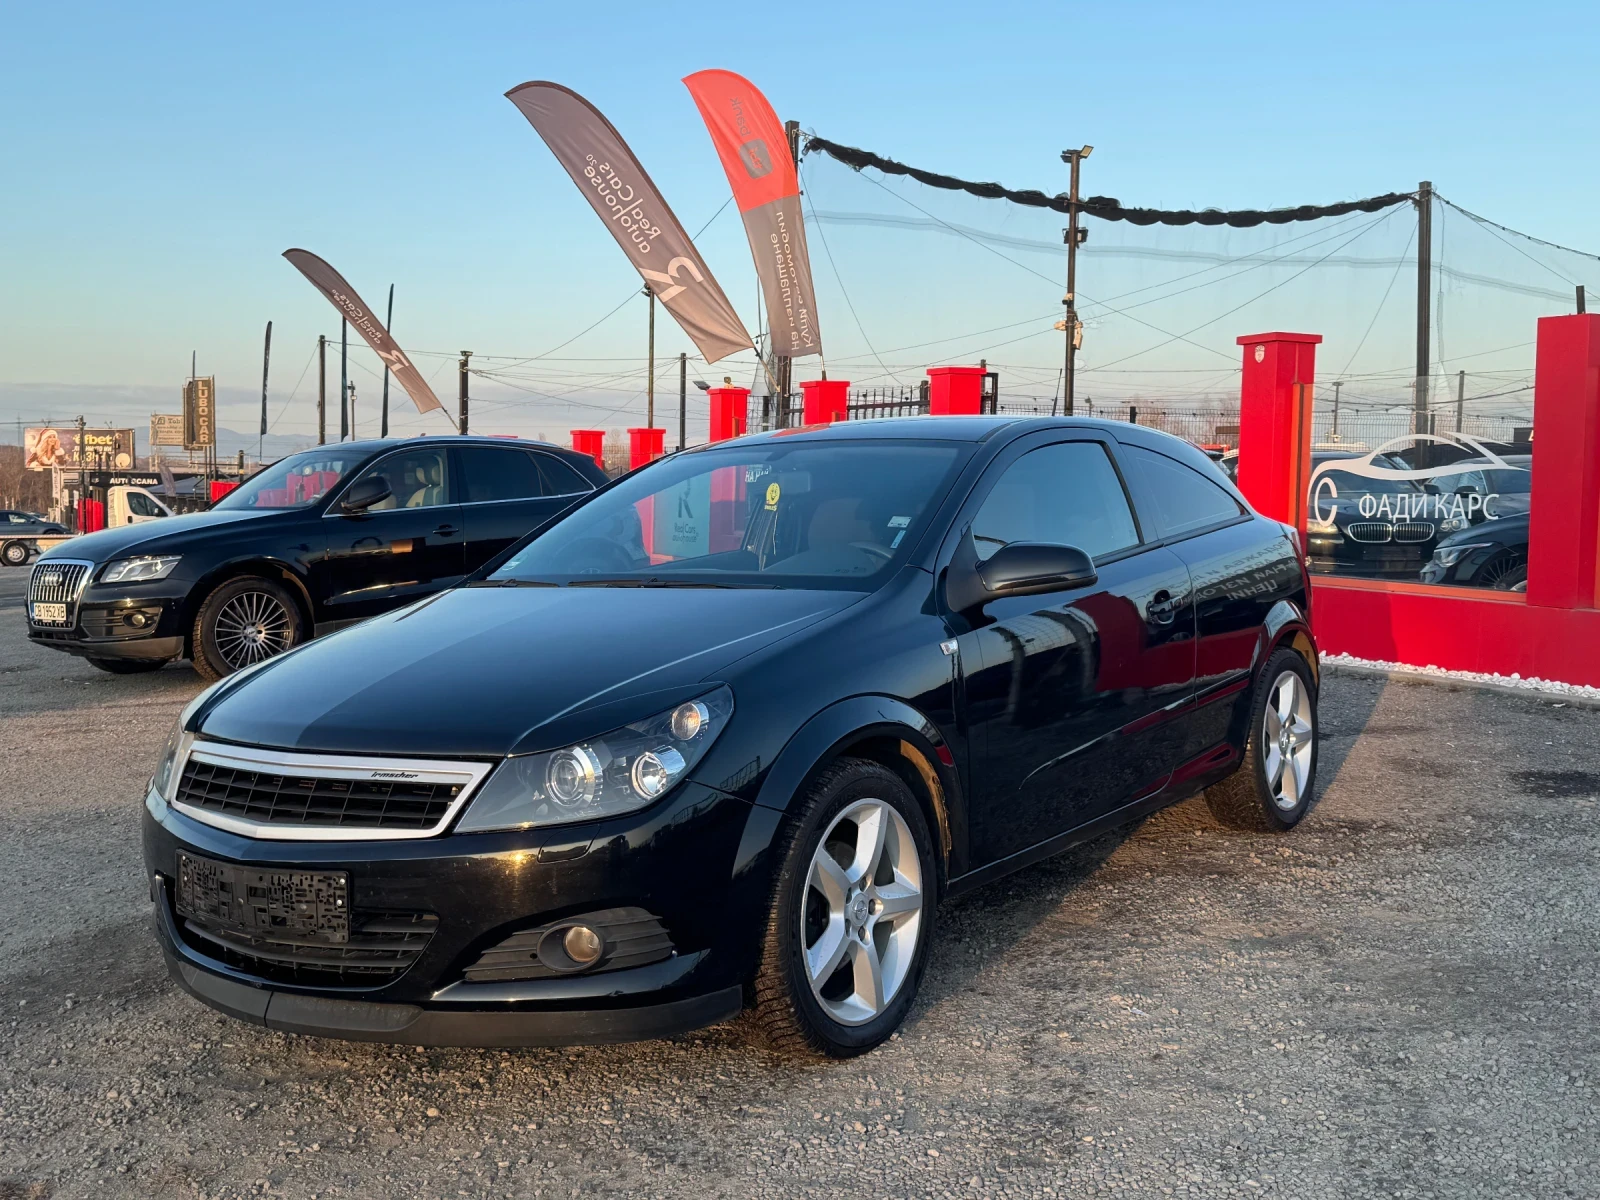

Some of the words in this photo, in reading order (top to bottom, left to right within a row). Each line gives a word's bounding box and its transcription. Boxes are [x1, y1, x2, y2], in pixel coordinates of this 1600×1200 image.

[198, 381, 208, 416] LUBO
[200, 418, 209, 442] CAR
[1358, 493, 1427, 524] ФАДИ
[1434, 494, 1500, 520] КАРС
[42, 605, 56, 618] 1952
[371, 771, 418, 779] irmscher
